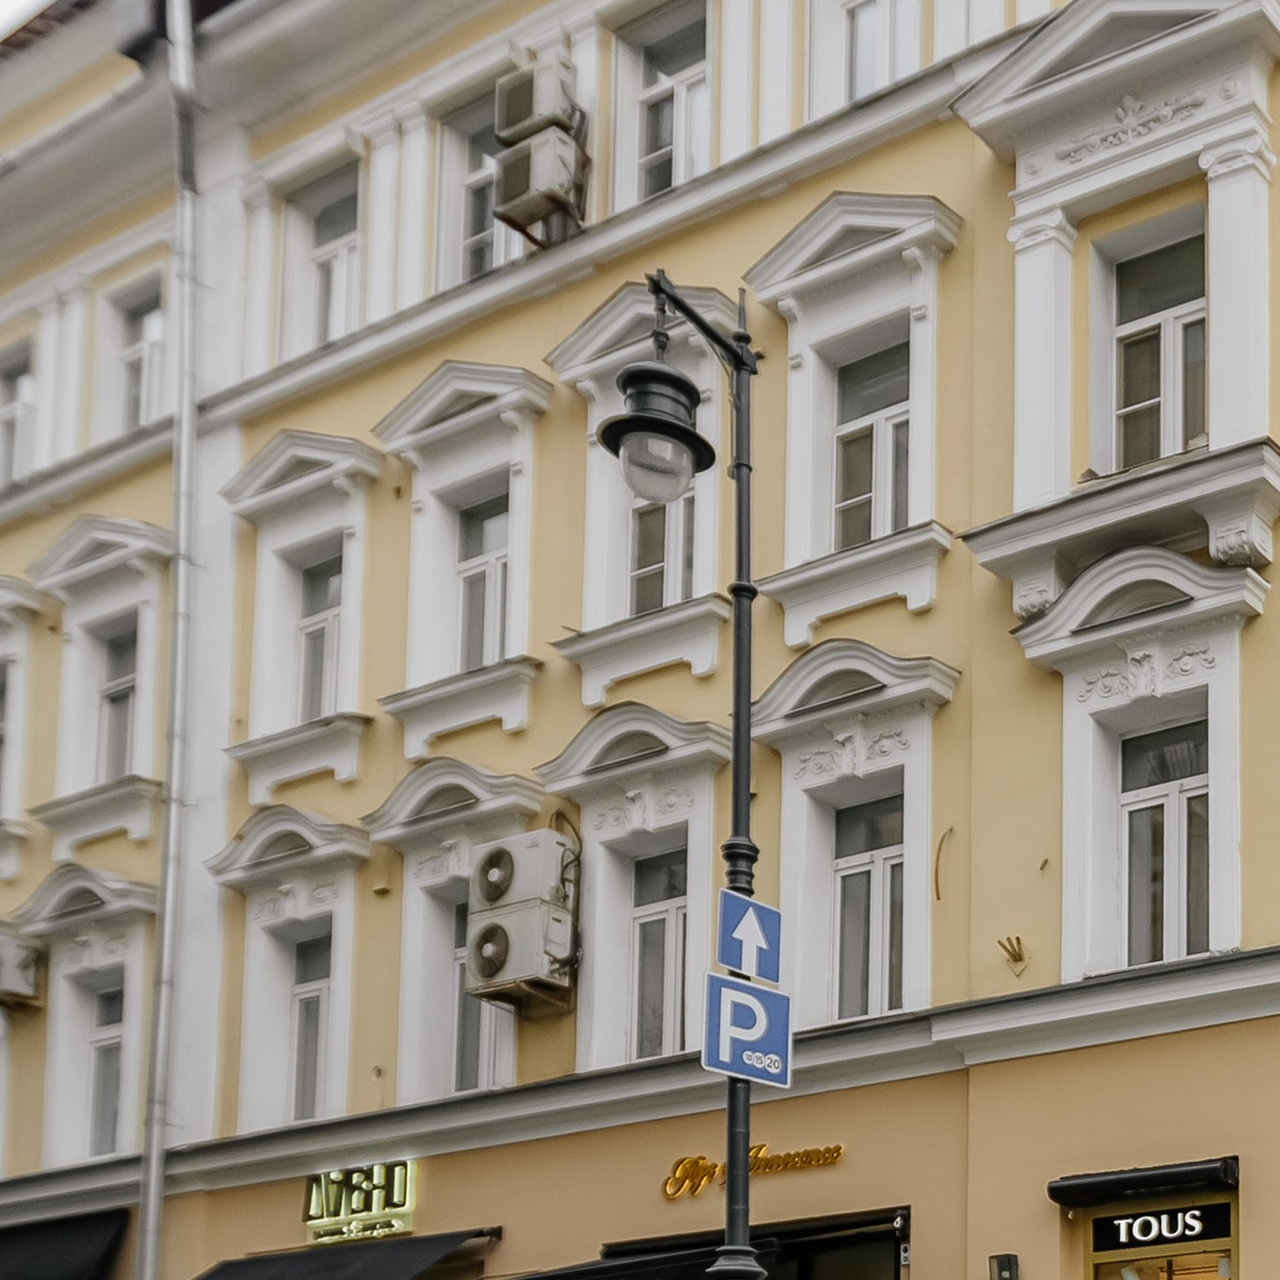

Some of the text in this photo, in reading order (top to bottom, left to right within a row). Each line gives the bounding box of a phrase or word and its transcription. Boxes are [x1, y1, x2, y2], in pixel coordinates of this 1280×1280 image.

[719, 986, 768, 1063] P
[766, 1057, 780, 1070] 20
[1113, 1209, 1203, 1243] TOUS
